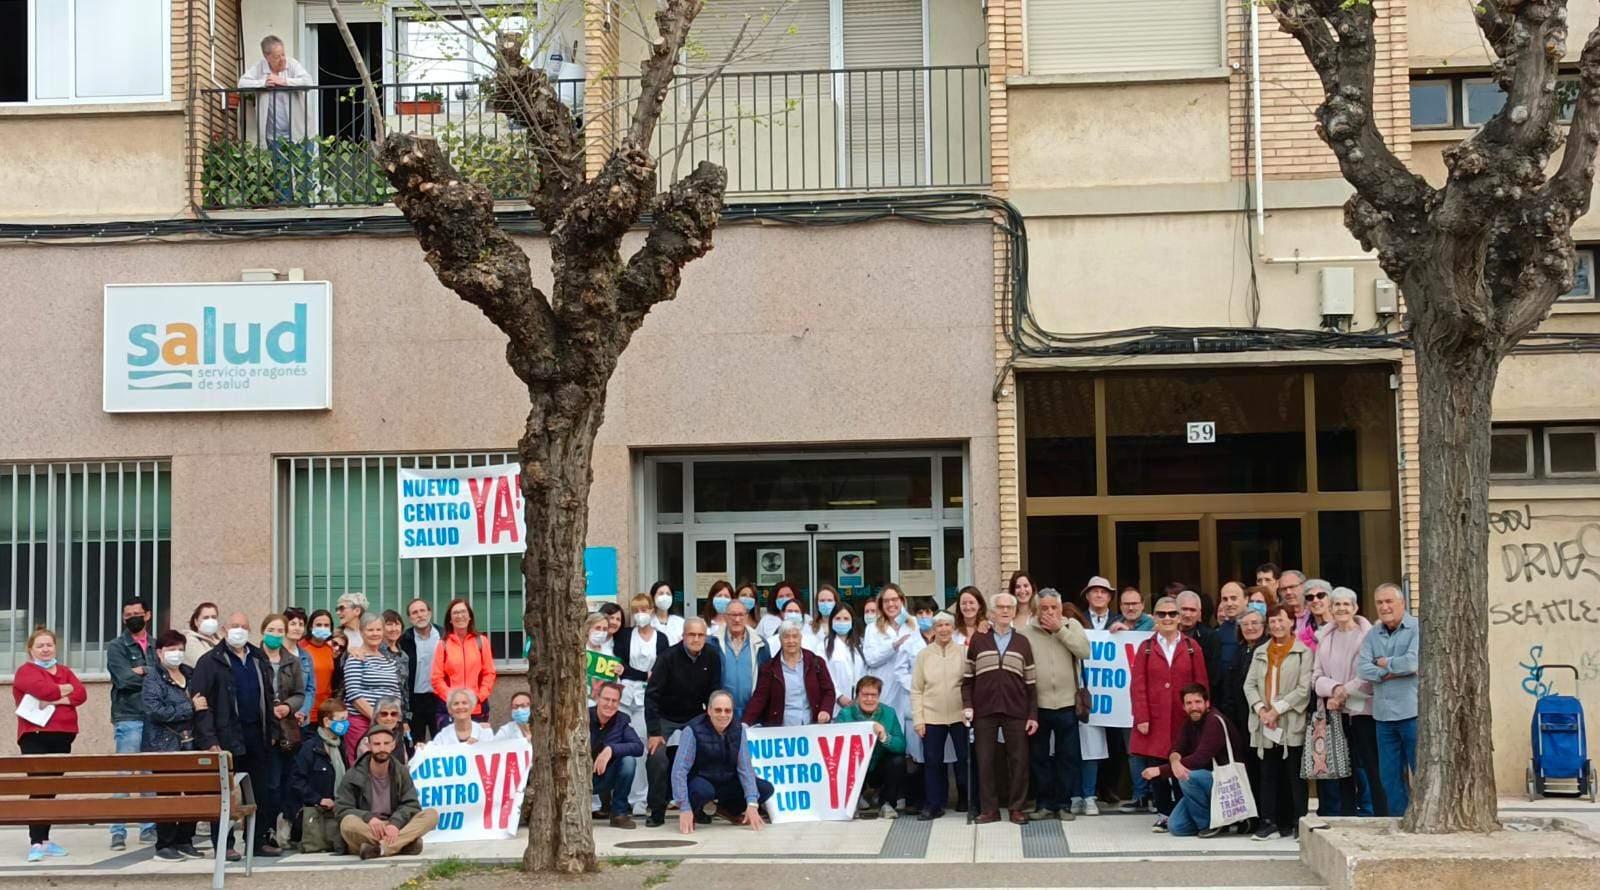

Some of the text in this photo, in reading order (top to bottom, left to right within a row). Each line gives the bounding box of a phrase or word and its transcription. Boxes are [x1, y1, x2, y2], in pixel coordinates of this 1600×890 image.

[127, 303, 307, 366] salud
[198, 366, 307, 380] servicio aragonés
[198, 379, 250, 390] de salud
[1188, 423, 1214, 441] 59
[403, 478, 460, 497] NUEVO
[404, 501, 471, 522] CENTRO
[404, 526, 459, 547] SALUD
[417, 782, 479, 808] ENTRO
